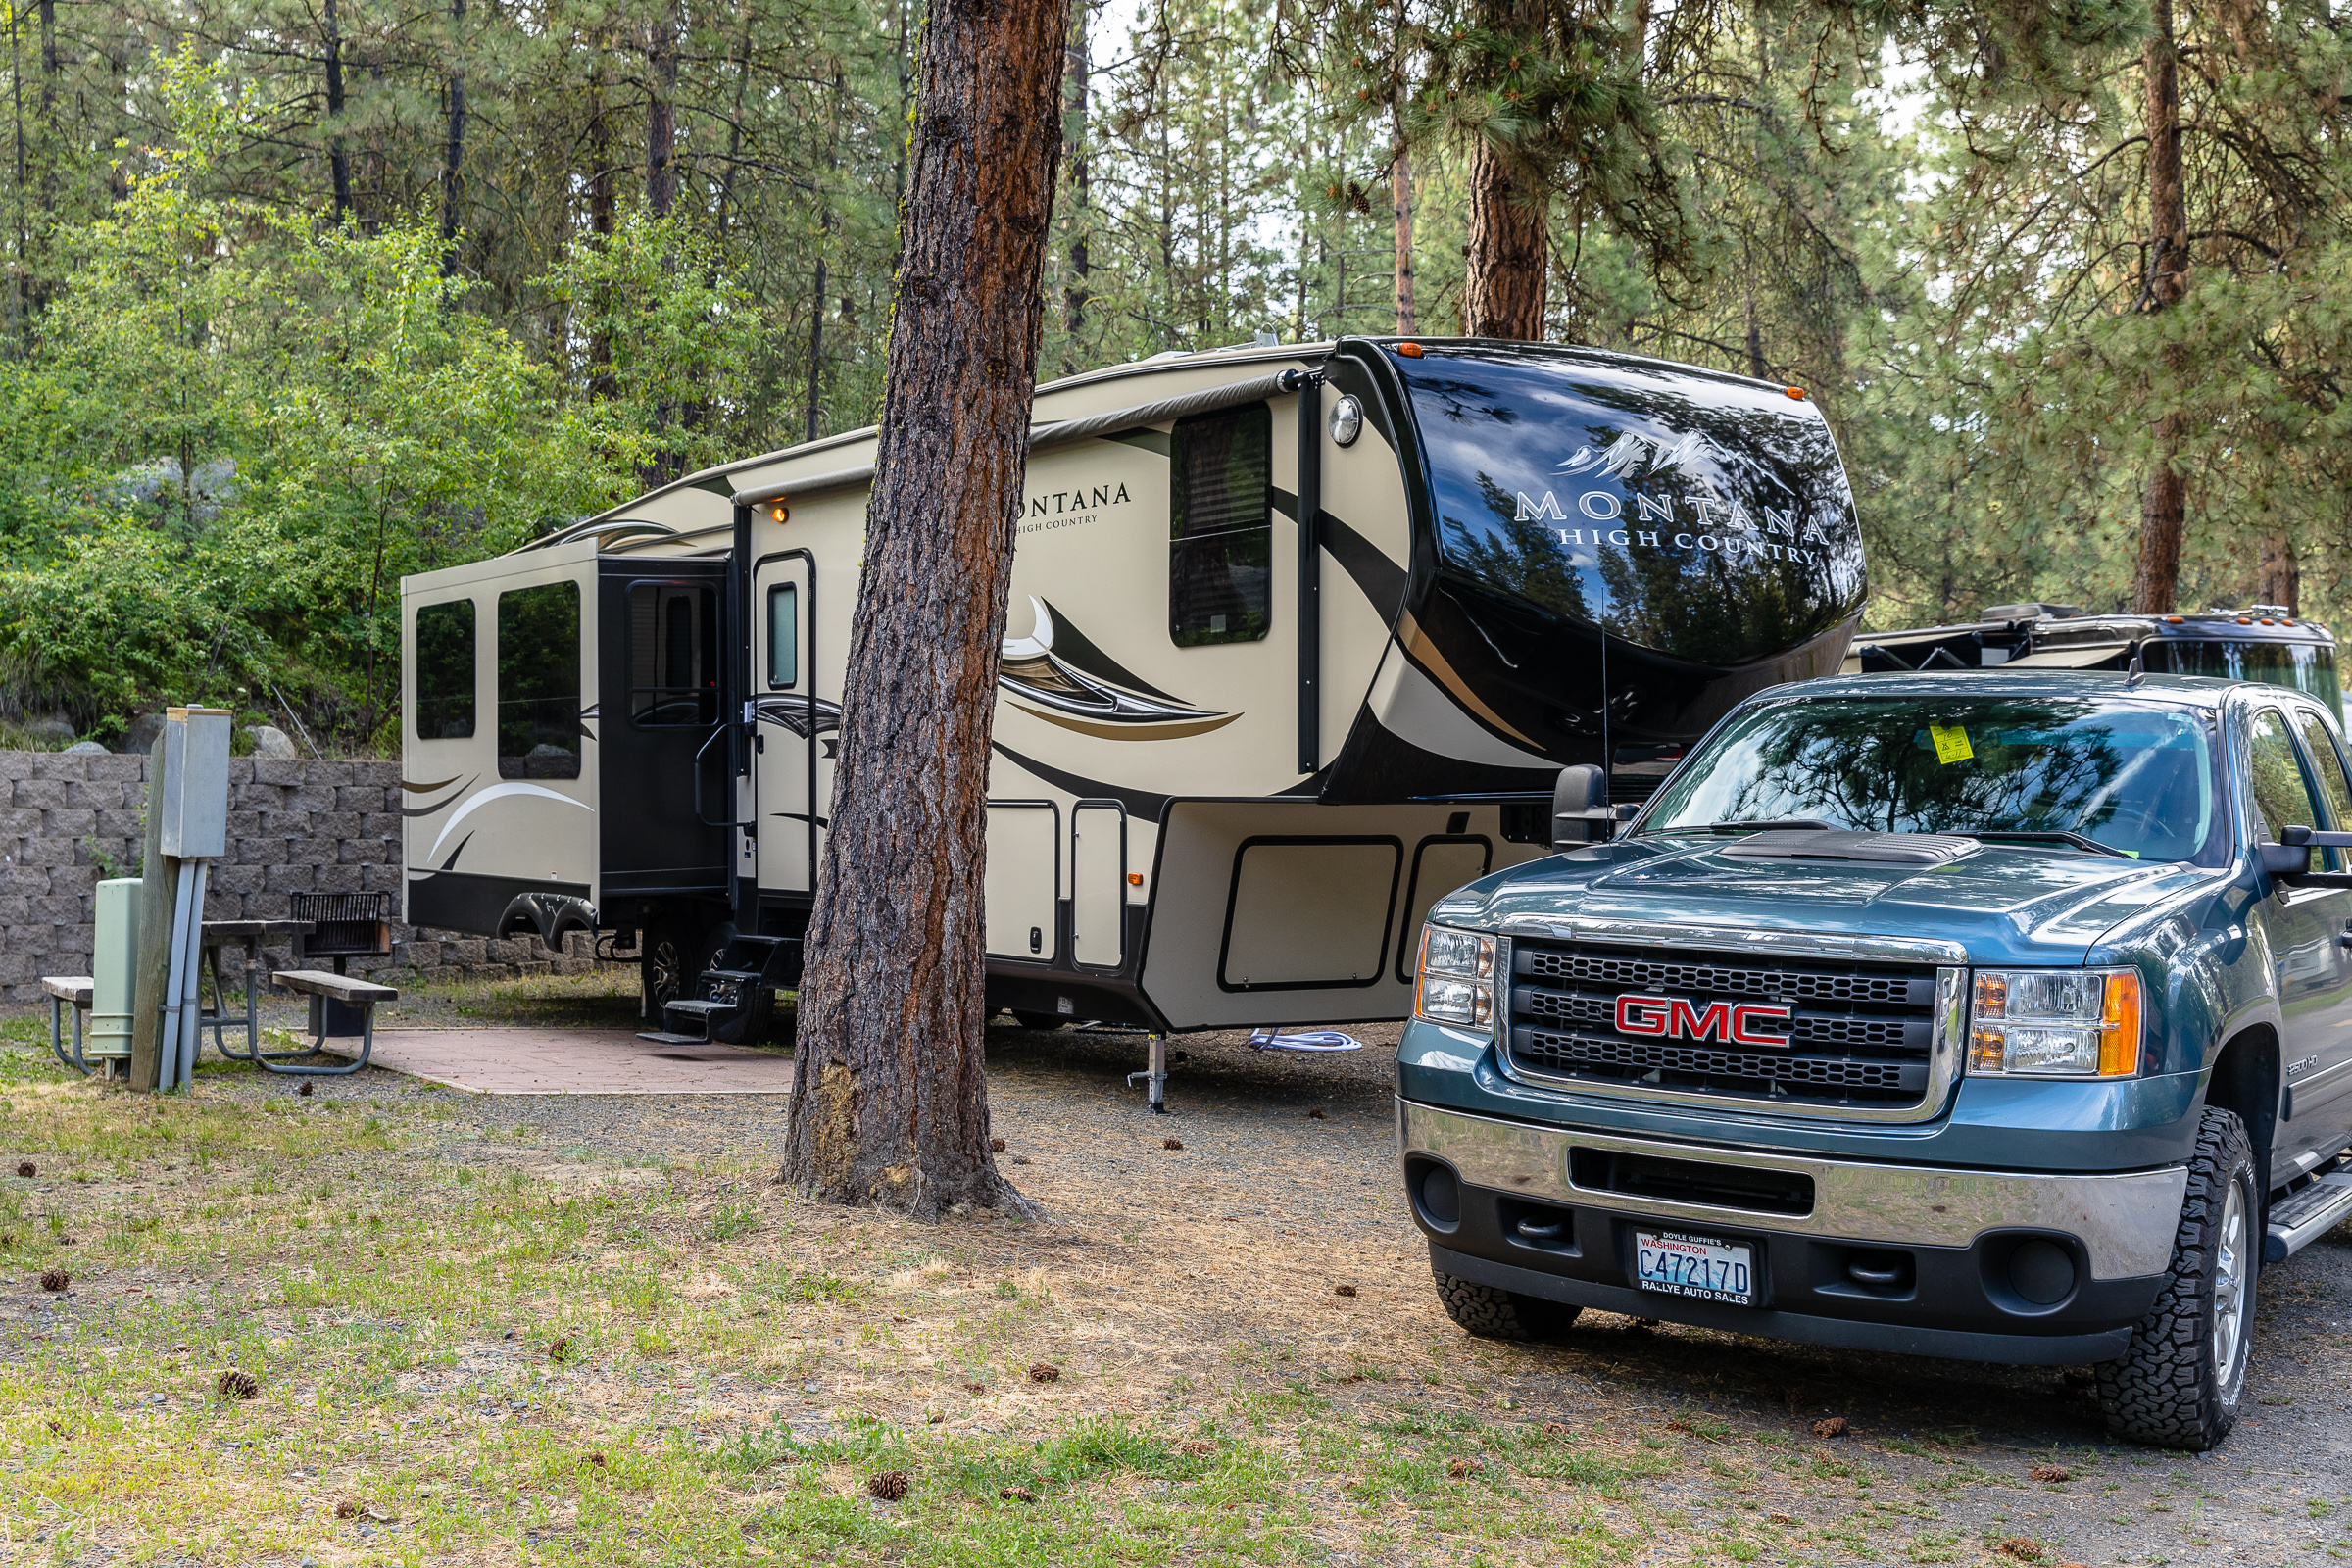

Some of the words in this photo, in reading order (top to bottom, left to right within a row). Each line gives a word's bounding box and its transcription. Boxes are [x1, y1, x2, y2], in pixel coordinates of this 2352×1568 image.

[1017, 482, 1131, 520] NTANA
[1514, 490, 1831, 547] MONTANA
[1046, 514, 1098, 530] COUNTRY
[1560, 528, 1661, 548] HIGH
[1675, 532, 1816, 566] COUNTRY
[1614, 993, 1792, 1049] GMC
[1641, 1238, 1707, 1255] WASHINGTON
[1663, 1232, 1688, 1242] DOYLE
[1688, 1236, 1722, 1247] GUFFIE'S
[1640, 1249, 1748, 1293] C47217D
[1642, 1280, 1681, 1295] RALLYE
[1683, 1287, 1712, 1299] AUTO
[1714, 1292, 1749, 1305] SALES
